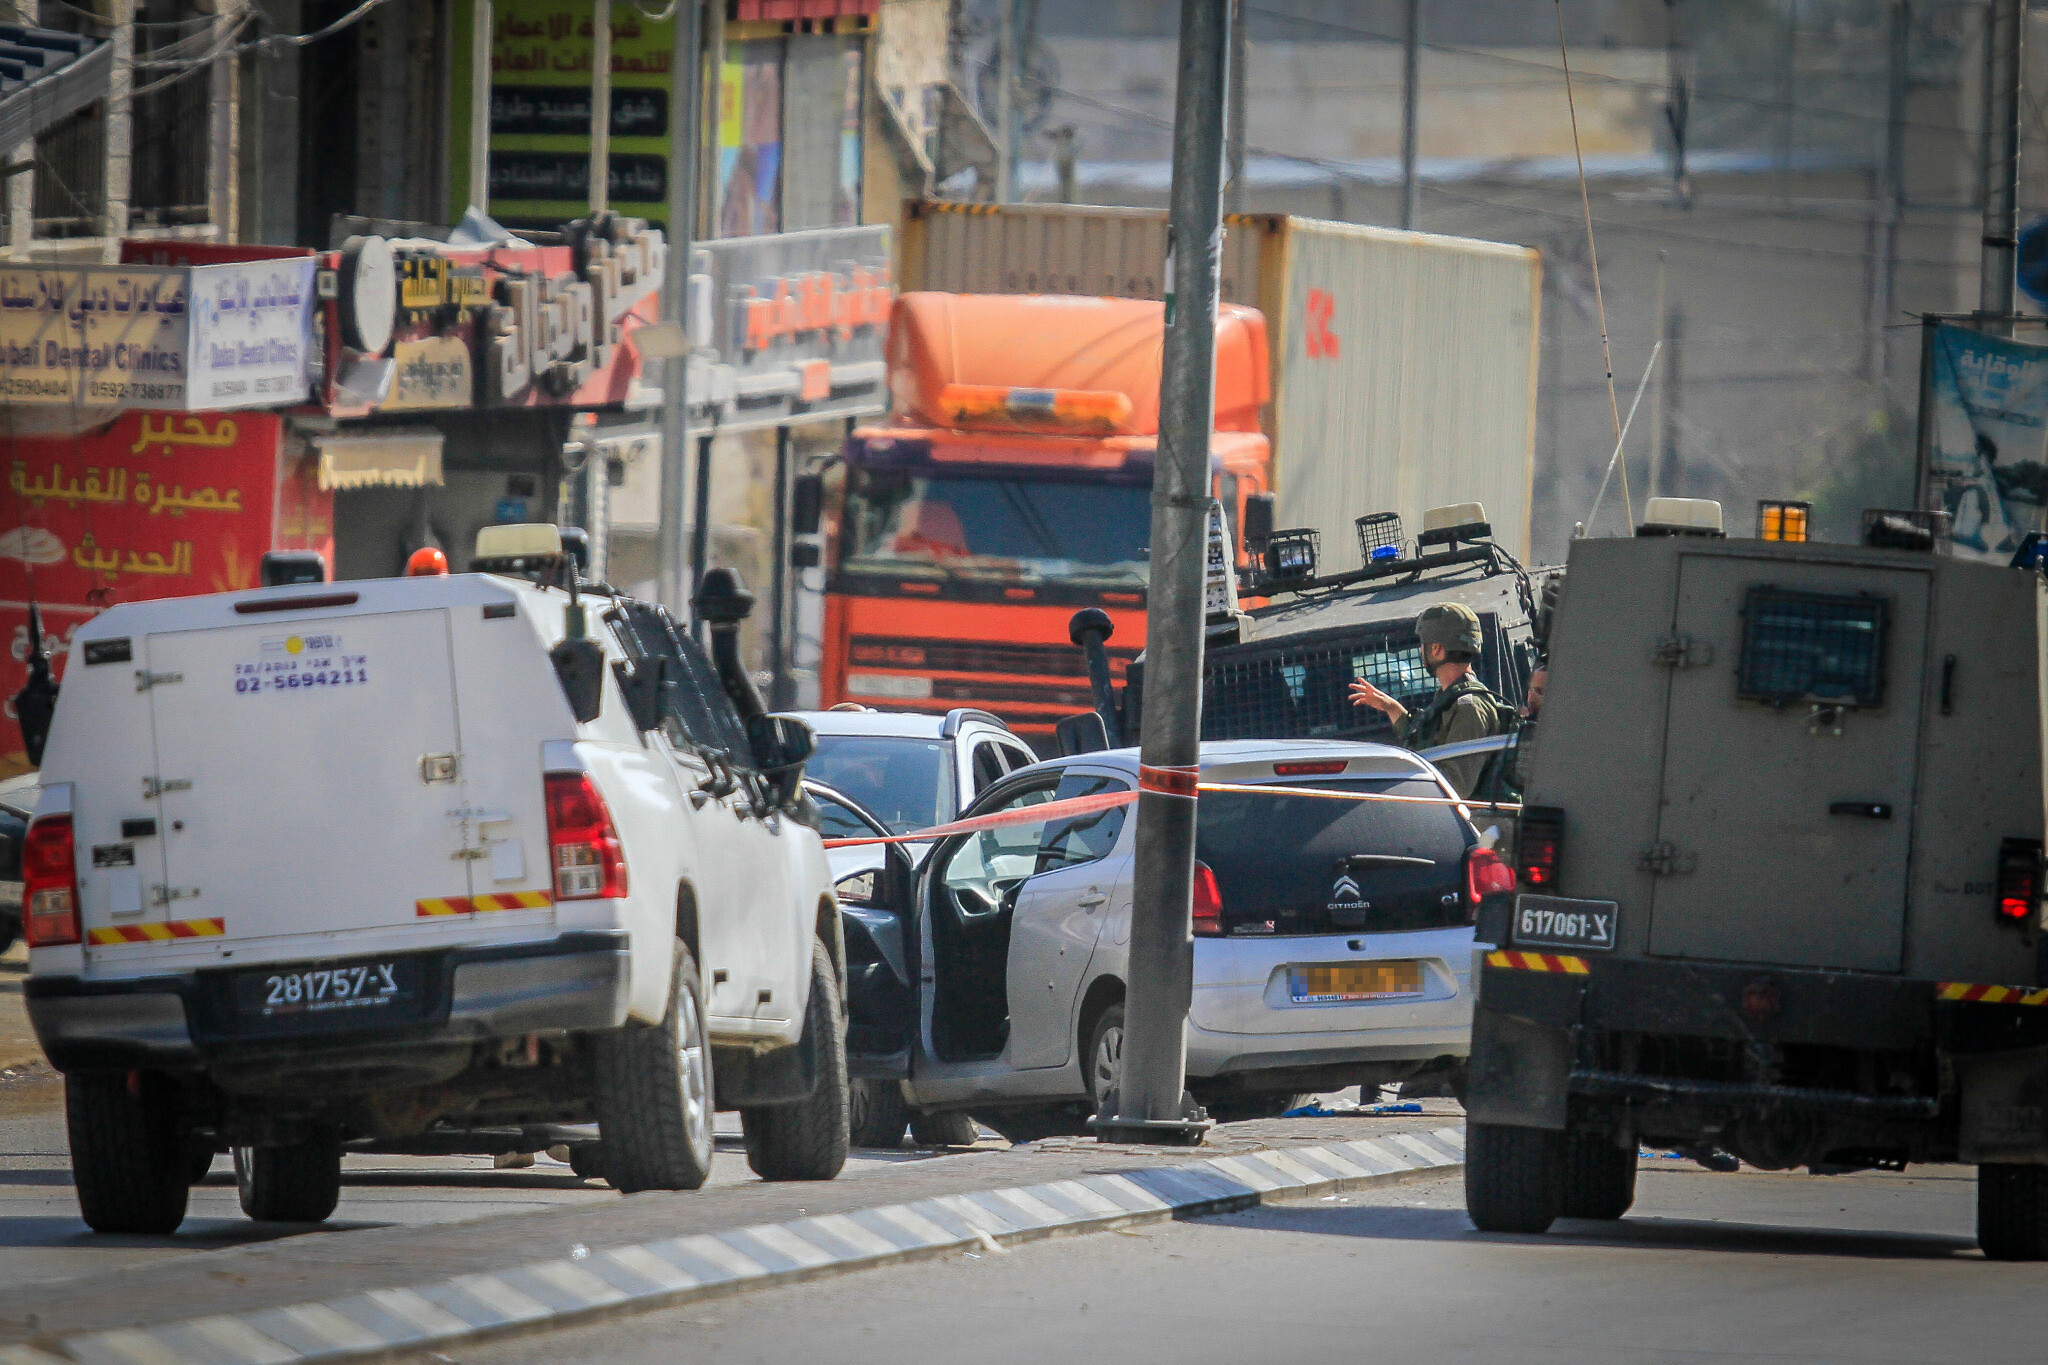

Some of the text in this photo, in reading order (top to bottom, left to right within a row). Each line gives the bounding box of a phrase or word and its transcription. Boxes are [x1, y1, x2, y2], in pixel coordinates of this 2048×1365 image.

[45, 340, 111, 369] Dental
[115, 342, 182, 371] Clinics
[9, 460, 243, 517] عصيرة القبلية
[73, 530, 193, 581] الحديث
[235, 668, 368, 693] 02-5694211
